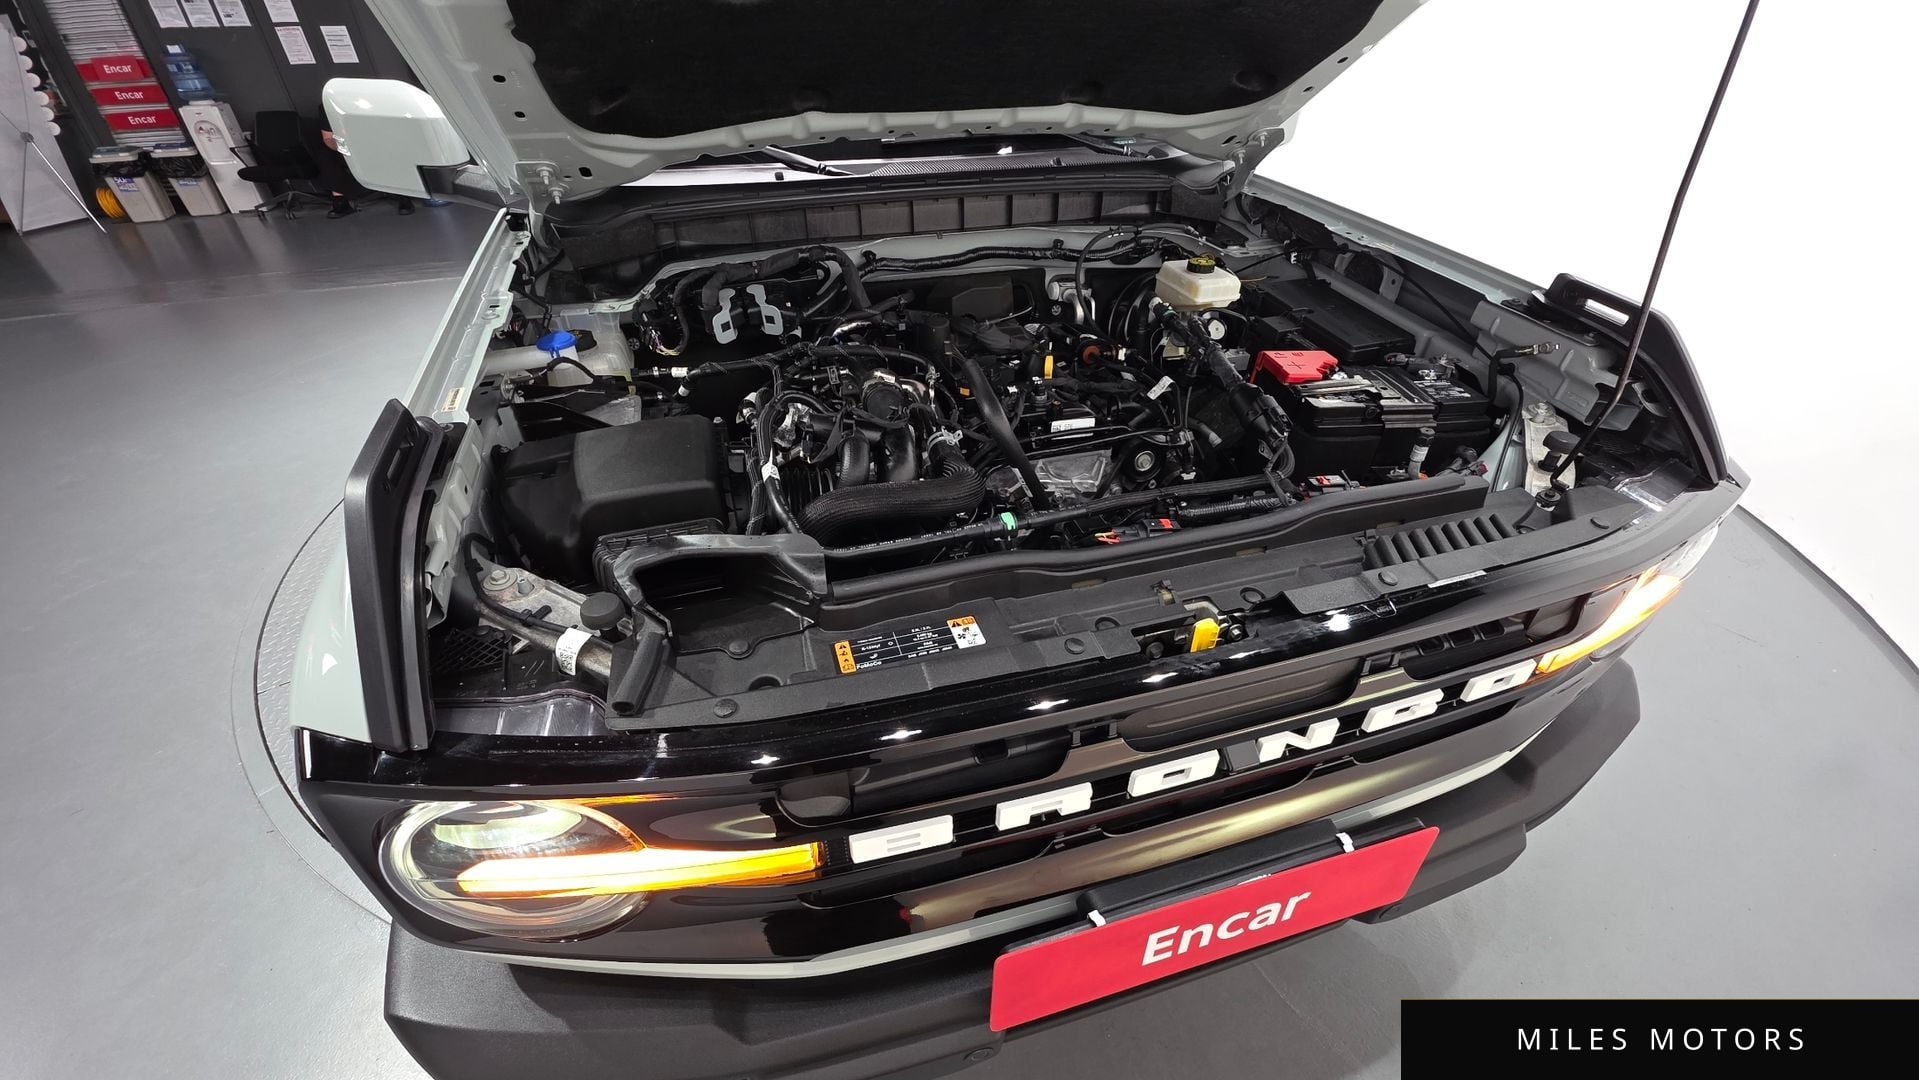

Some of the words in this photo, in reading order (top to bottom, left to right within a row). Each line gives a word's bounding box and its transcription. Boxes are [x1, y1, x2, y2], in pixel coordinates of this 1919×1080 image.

[103, 63, 133, 74] Encar
[114, 90, 144, 100] Encar
[128, 114, 157, 125] Encar
[848, 658, 1537, 864] BRONCO
[1141, 891, 1312, 966] Encar
